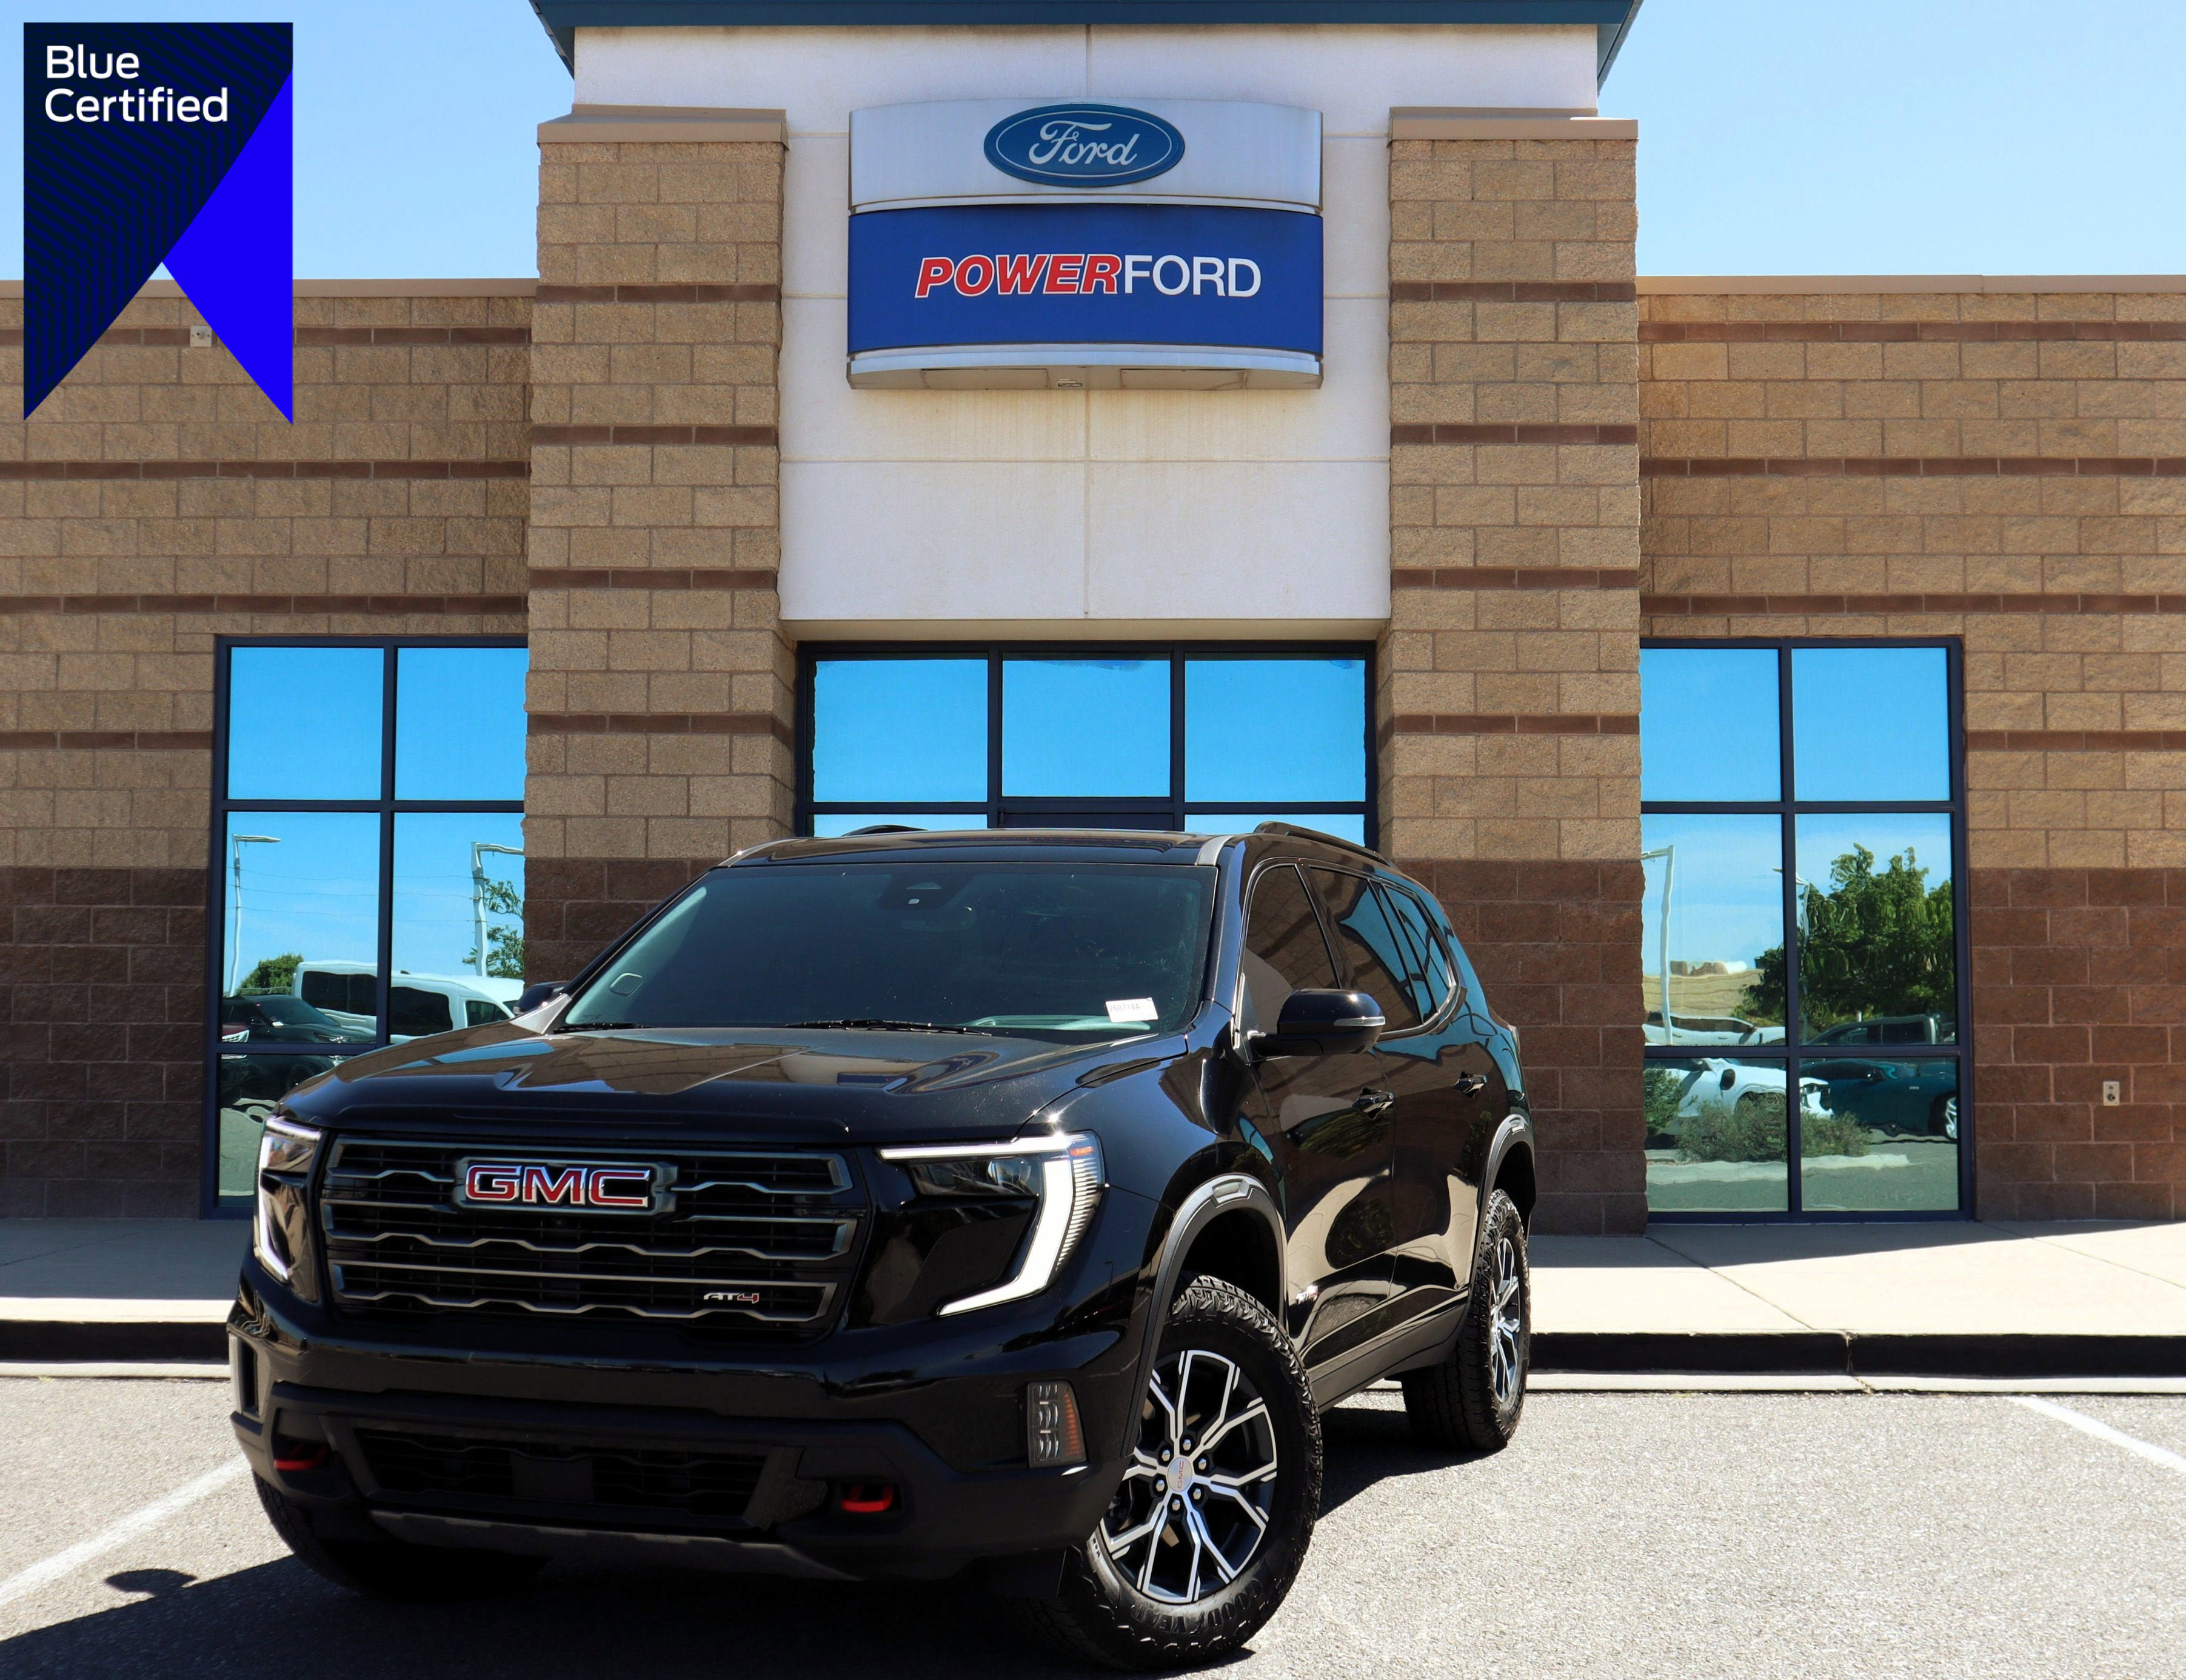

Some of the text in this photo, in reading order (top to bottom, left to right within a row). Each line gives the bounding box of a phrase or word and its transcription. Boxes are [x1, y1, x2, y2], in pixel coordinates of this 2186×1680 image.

[1029, 119, 1139, 166] Ford
[466, 1165, 651, 1208] GMC
[703, 1292, 760, 1304] AT4
[1176, 1460, 1185, 1489] GMC
